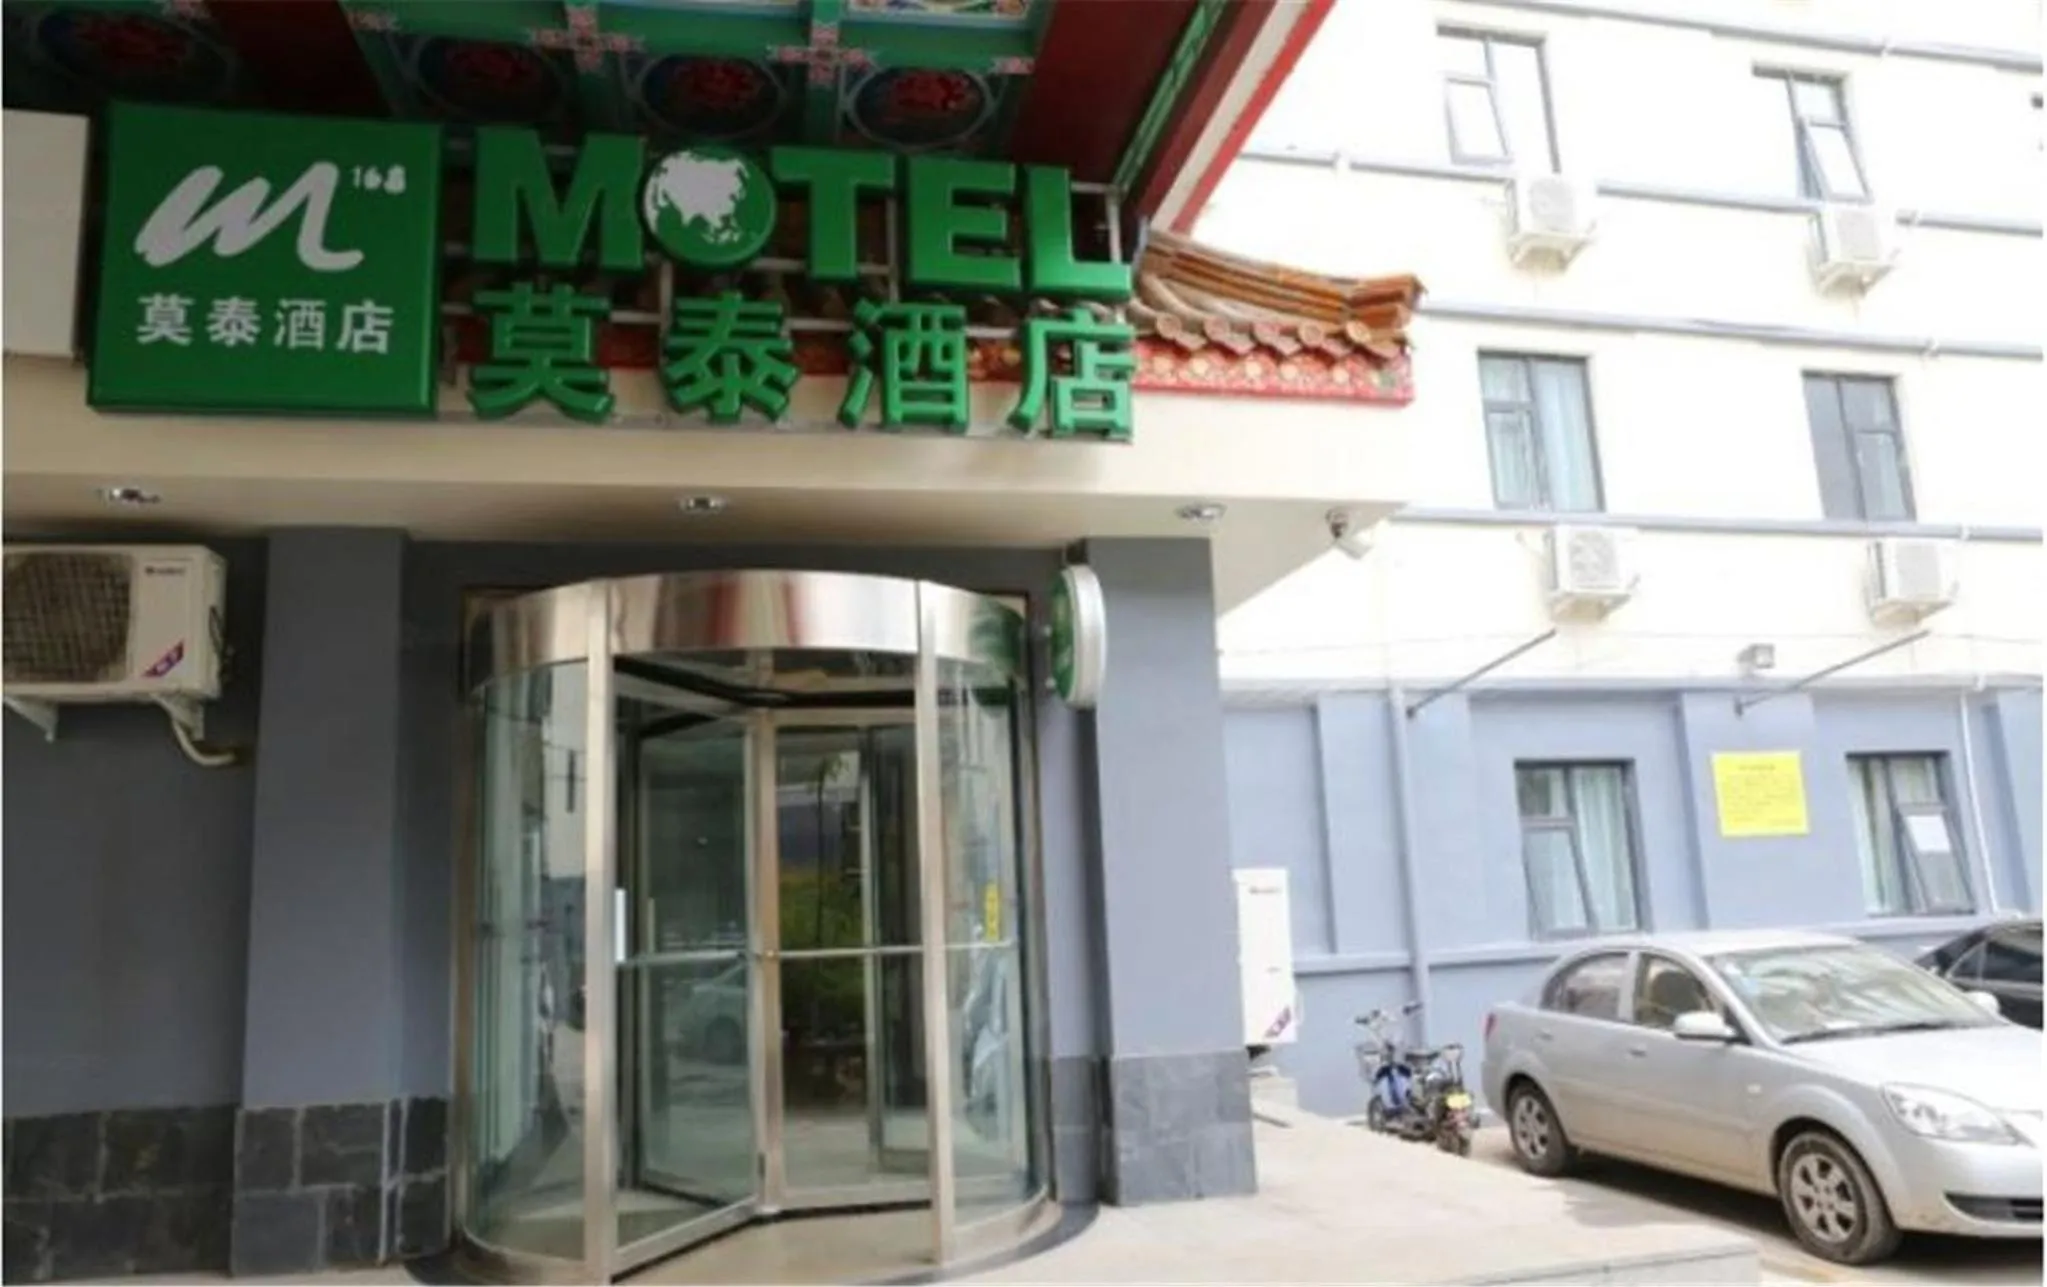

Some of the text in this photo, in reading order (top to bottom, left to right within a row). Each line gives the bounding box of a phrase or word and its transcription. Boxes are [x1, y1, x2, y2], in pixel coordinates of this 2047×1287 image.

[351, 164, 406, 196] 168
[472, 125, 1132, 298] MOTEL
[136, 292, 395, 355] 莫泰酒店
[468, 283, 1134, 443] 莫泰酒店
